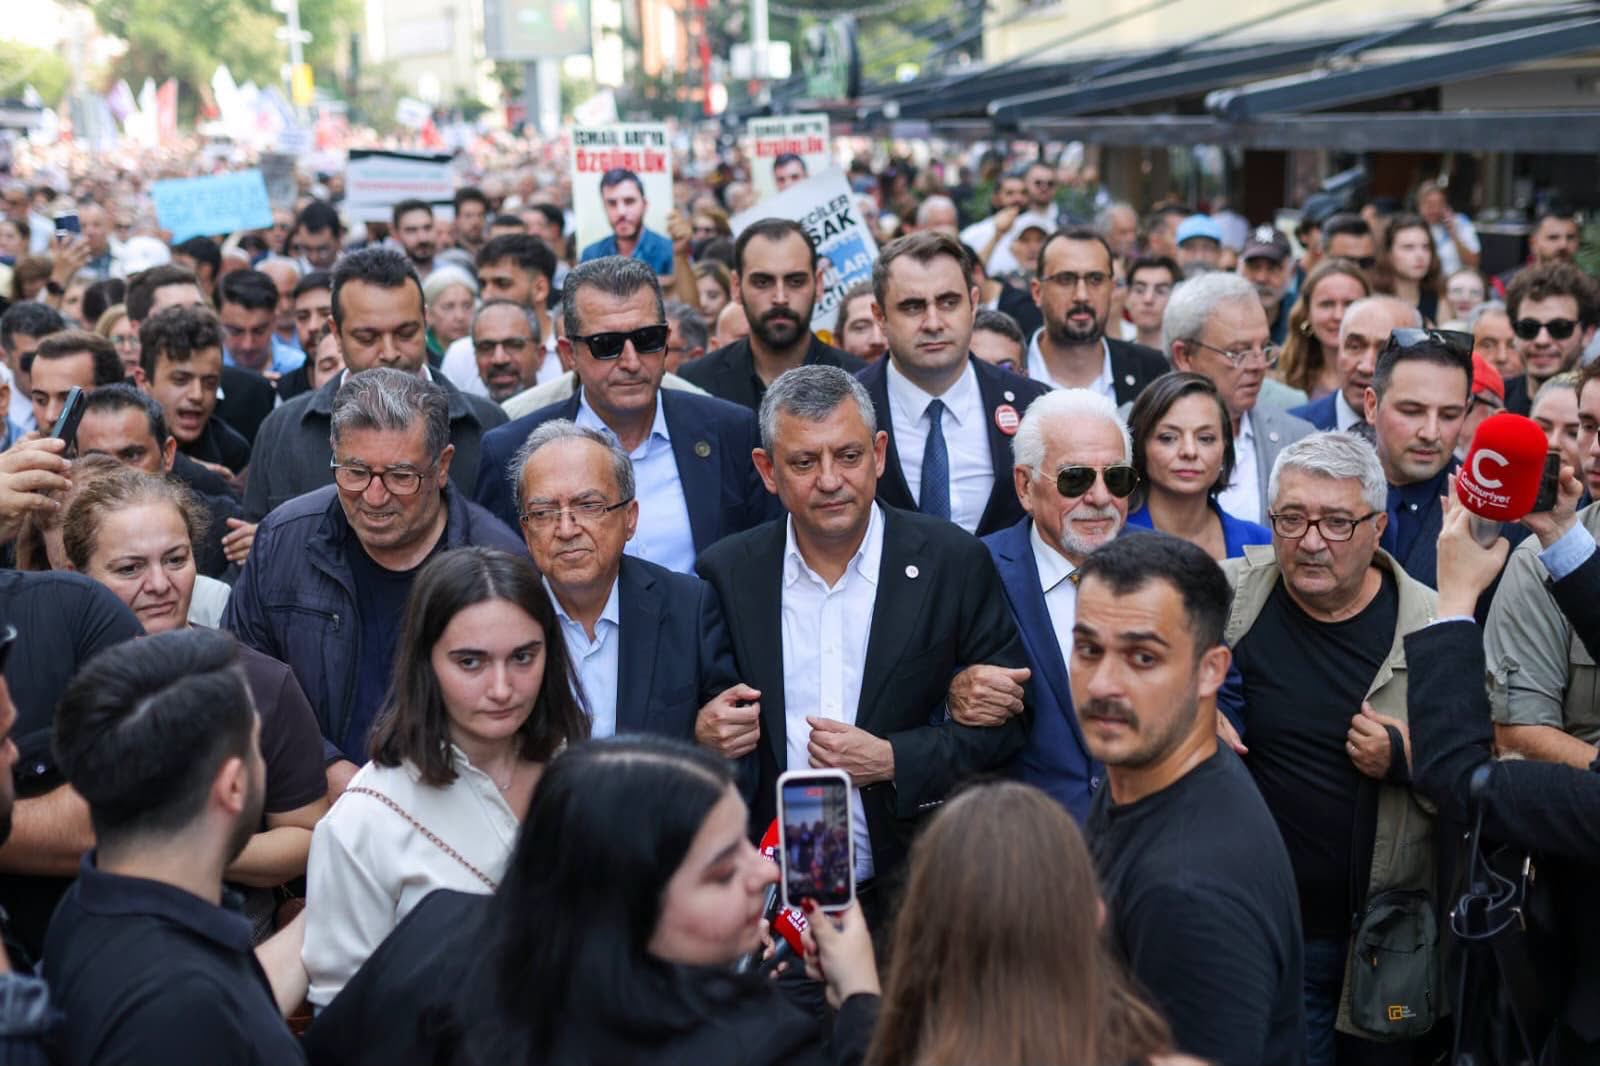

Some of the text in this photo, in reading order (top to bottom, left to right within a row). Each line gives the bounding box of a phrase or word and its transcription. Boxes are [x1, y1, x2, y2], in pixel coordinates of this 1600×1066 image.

[575, 147, 666, 173] ÖZGÜRLÜK
[799, 194, 850, 226] ECİLER
[809, 208, 856, 248] SAK
[1472, 448, 1510, 489] C
[1461, 471, 1511, 504] Cumhuriyet
[1468, 494, 1488, 508] TV
